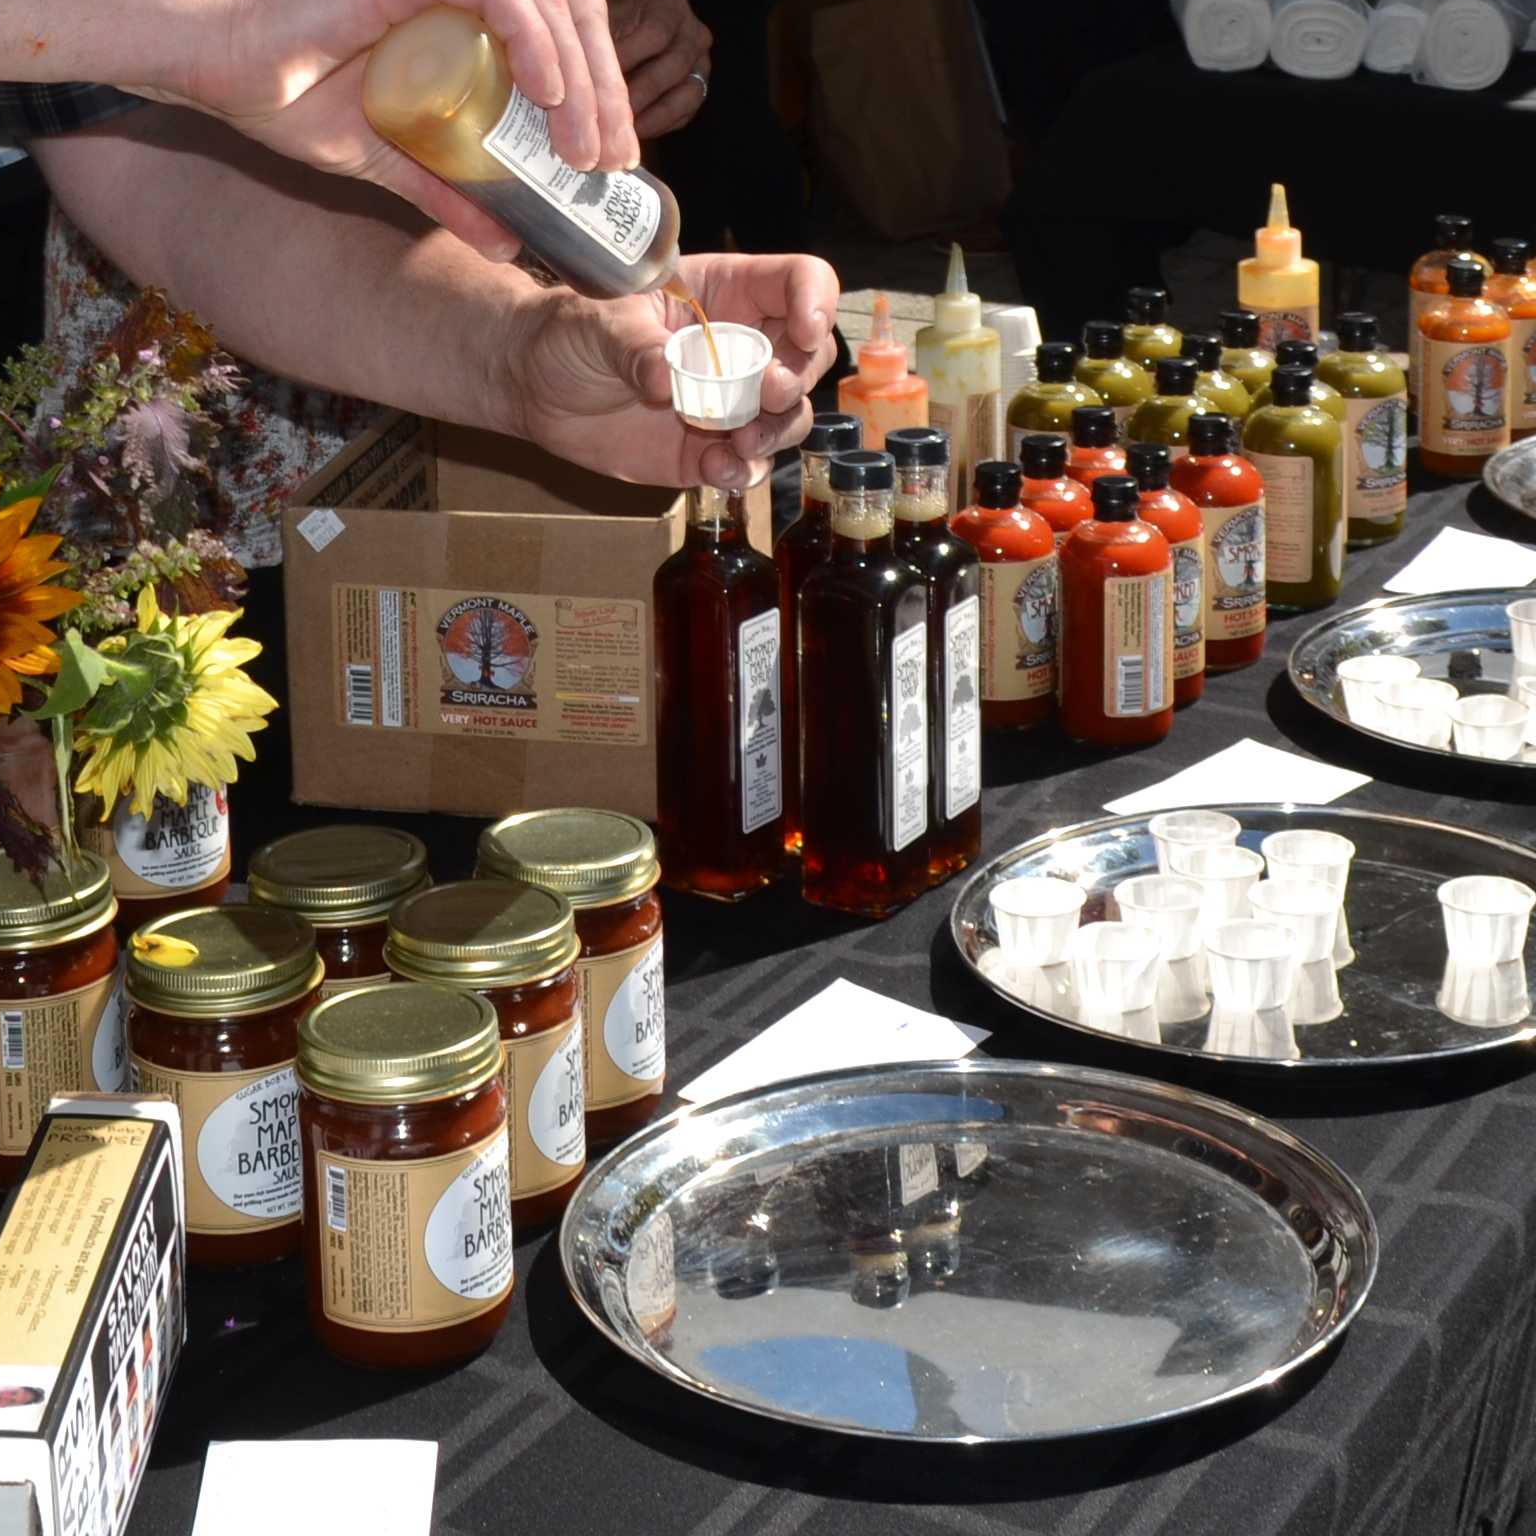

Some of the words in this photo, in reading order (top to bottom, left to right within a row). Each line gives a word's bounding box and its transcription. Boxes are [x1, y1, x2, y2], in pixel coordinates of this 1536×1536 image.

[440, 598, 494, 629] VERMONT
[498, 602, 535, 634] MAPLE
[452, 690, 528, 706] SRIRACHA
[440, 714, 469, 724] VERY
[473, 715, 498, 725] HOT
[500, 717, 537, 728] SAUCE
[161, 800, 207, 829] MAPLE
[145, 816, 218, 850] BARBEQUE
[174, 844, 201, 860] SAUCE
[236, 1083, 263, 1101] SUGAR
[249, 1089, 300, 1125] SMOK
[47, 1133, 145, 1145] PROMISE
[258, 1115, 297, 1148] MAP
[238, 1139, 300, 1176] BARBE
[273, 1164, 300, 1185] SAUC
[95, 1198, 115, 1213] Our
[77, 1214, 109, 1248] products
[76, 1249, 92, 1263] are
[108, 1200, 155, 1337] SAVORY
